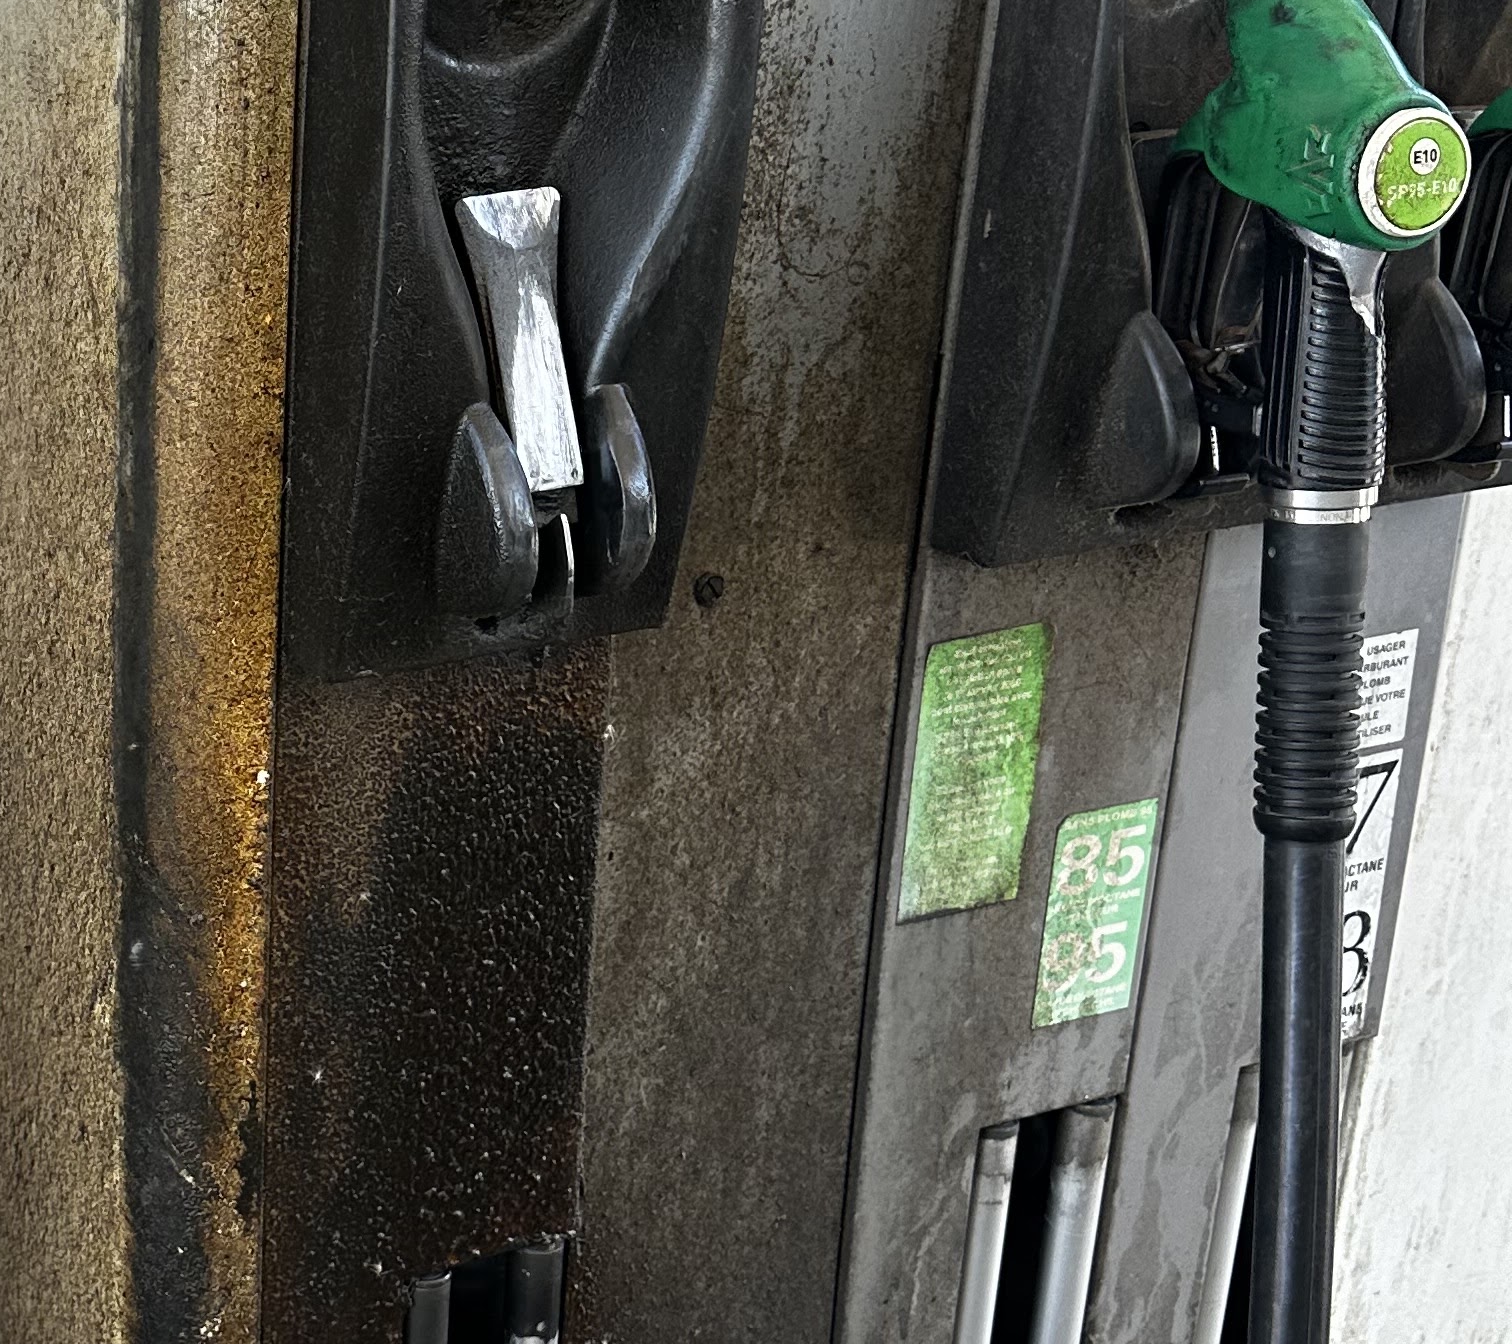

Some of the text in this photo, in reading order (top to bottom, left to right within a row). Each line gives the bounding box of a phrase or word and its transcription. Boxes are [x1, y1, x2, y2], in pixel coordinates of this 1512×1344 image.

[1413, 148, 1438, 165] E10
[1366, 640, 1406, 656] USAGER
[1362, 656, 1409, 673] RBURANT
[1362, 676, 1391, 690] LOMB
[1375, 689, 1406, 703] VOTRE
[1345, 758, 1400, 855] 7
[1097, 809, 1138, 824] PLOMB
[1056, 823, 1147, 896] 85
[1043, 920, 1127, 994] 95
